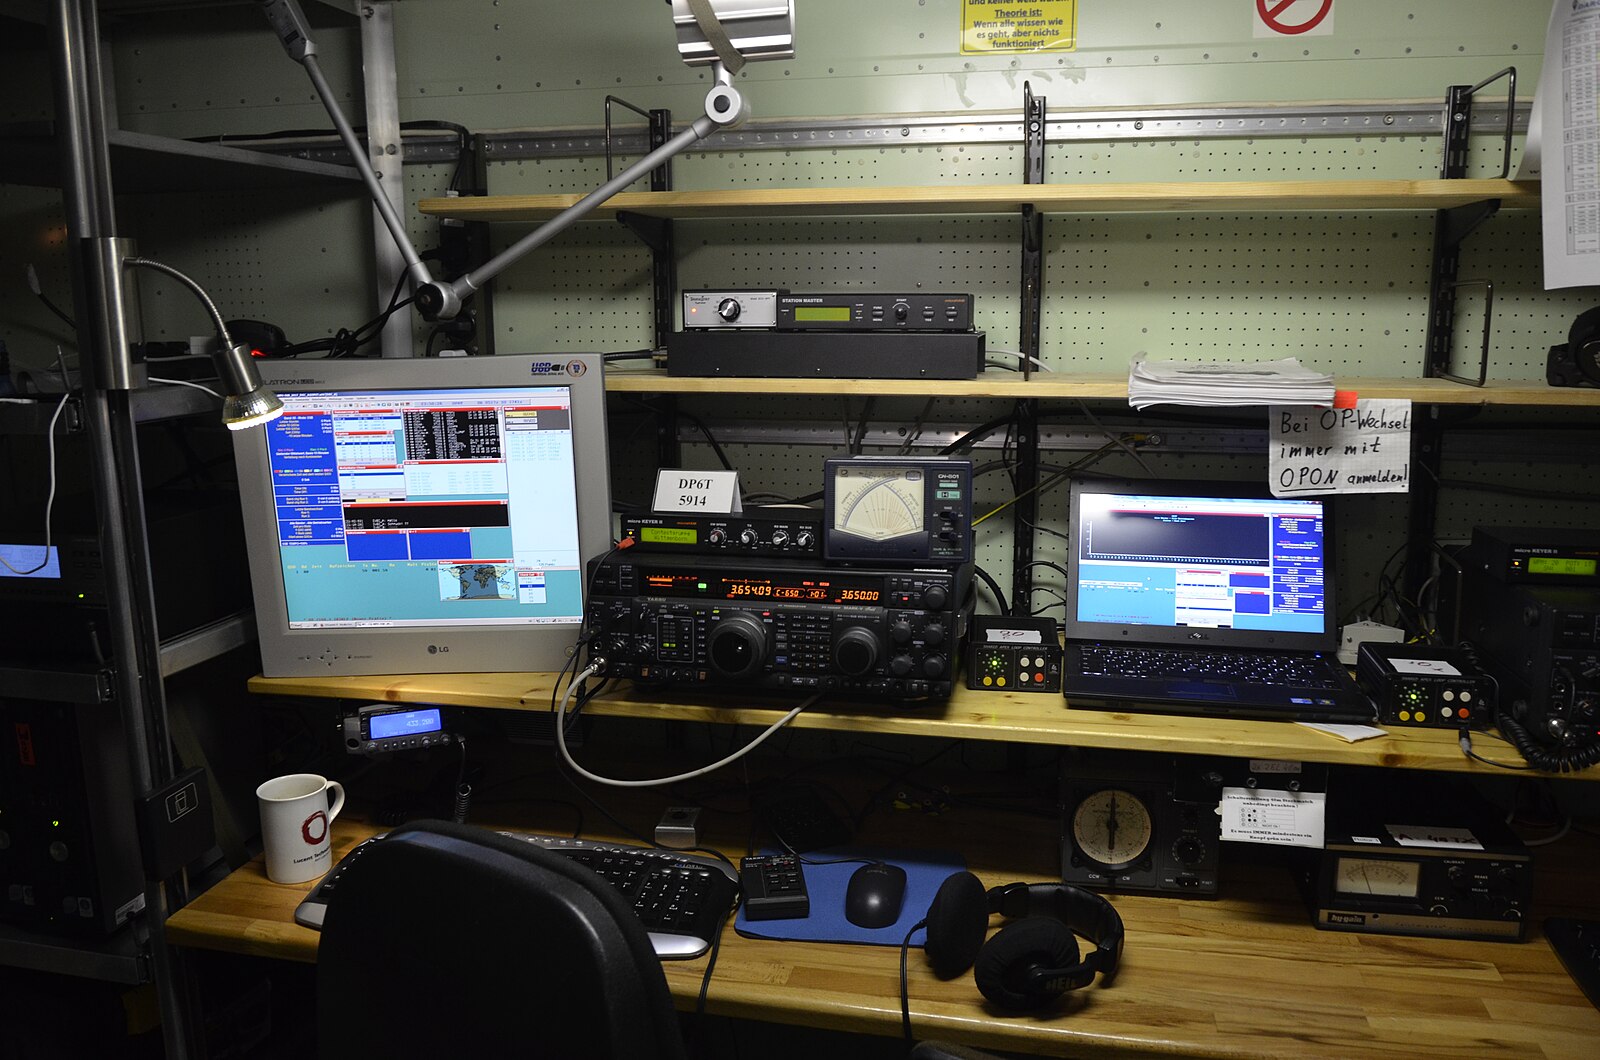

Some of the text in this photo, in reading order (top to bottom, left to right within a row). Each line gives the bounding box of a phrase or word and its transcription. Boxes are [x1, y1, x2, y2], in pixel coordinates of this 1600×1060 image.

[994, 8, 1042, 18] Theorie ist:
[974, 20, 998, 28] Wenn
[1017, 19, 1046, 27] wissen
[988, 30, 1010, 40] geht,
[1012, 29, 1031, 37] aber
[1033, 28, 1059, 36] nichts
[992, 40, 1045, 48] funktioniert
[531, 362, 551, 372] USB
[1281, 408, 1408, 433] Bei OP-Wechsel
[1280, 436, 1380, 458] immer mit
[1280, 463, 1408, 488] OPON anmelden!
[678, 478, 713, 489] DP6T
[679, 495, 706, 506] 5914
